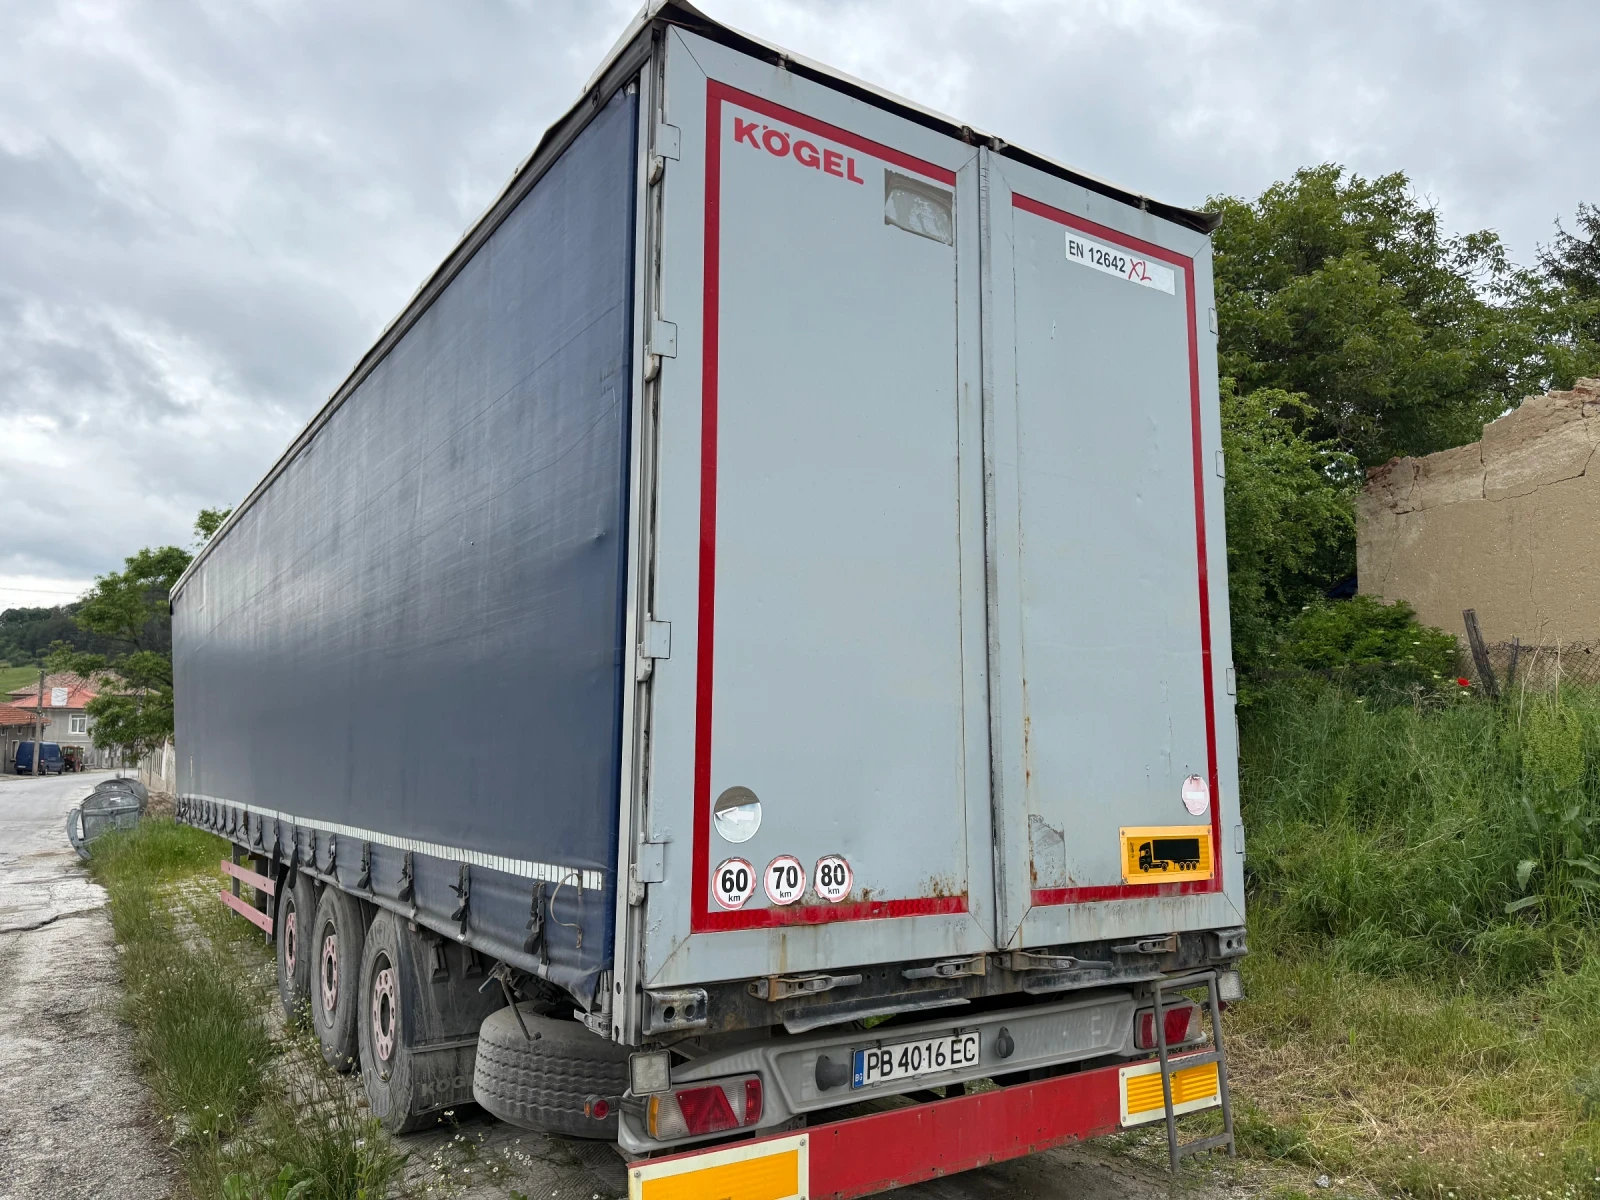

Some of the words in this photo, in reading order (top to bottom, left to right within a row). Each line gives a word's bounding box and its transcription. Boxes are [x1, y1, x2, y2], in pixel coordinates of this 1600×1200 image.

[734, 117, 864, 185] KÖGEL
[1069, 240, 1084, 259] EN
[1089, 247, 1126, 273] 12642
[1128, 258, 1152, 281] XL
[721, 868, 748, 893] 60
[773, 866, 798, 890] 70
[821, 863, 845, 887] 80
[728, 893, 741, 902] km
[779, 890, 792, 899] km
[827, 887, 840, 895] km
[866, 1049, 893, 1080] PB
[898, 1041, 946, 1073] 4016
[951, 1037, 976, 1065] EC
